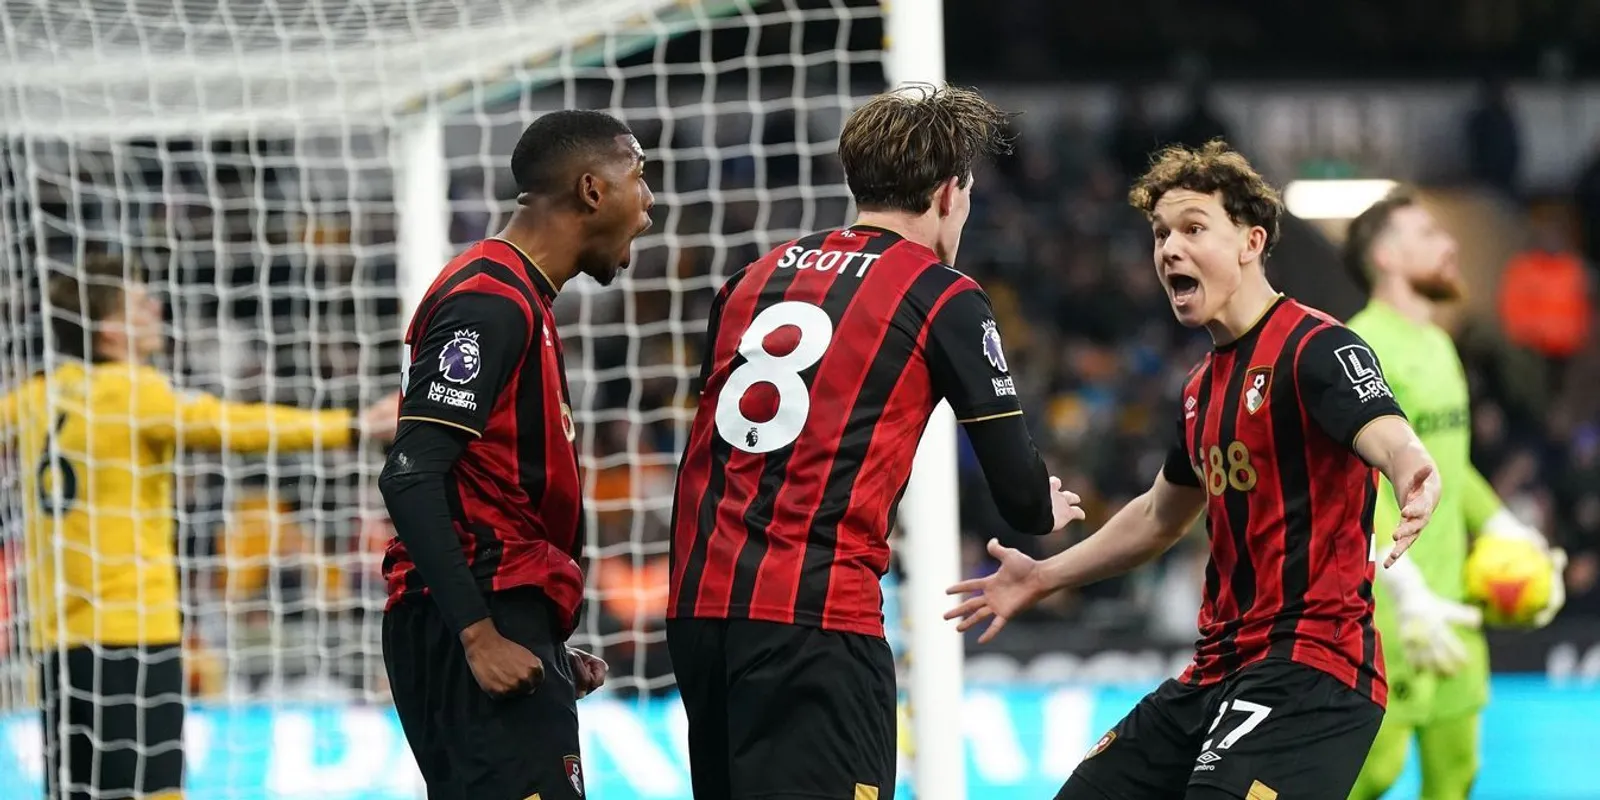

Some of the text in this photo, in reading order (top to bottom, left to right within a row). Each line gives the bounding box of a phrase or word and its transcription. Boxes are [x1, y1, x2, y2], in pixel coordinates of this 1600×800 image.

[777, 245, 881, 278] SCOTT
[715, 301, 833, 453] 8
[430, 381, 475, 402] No room
[443, 395, 477, 411] racism
